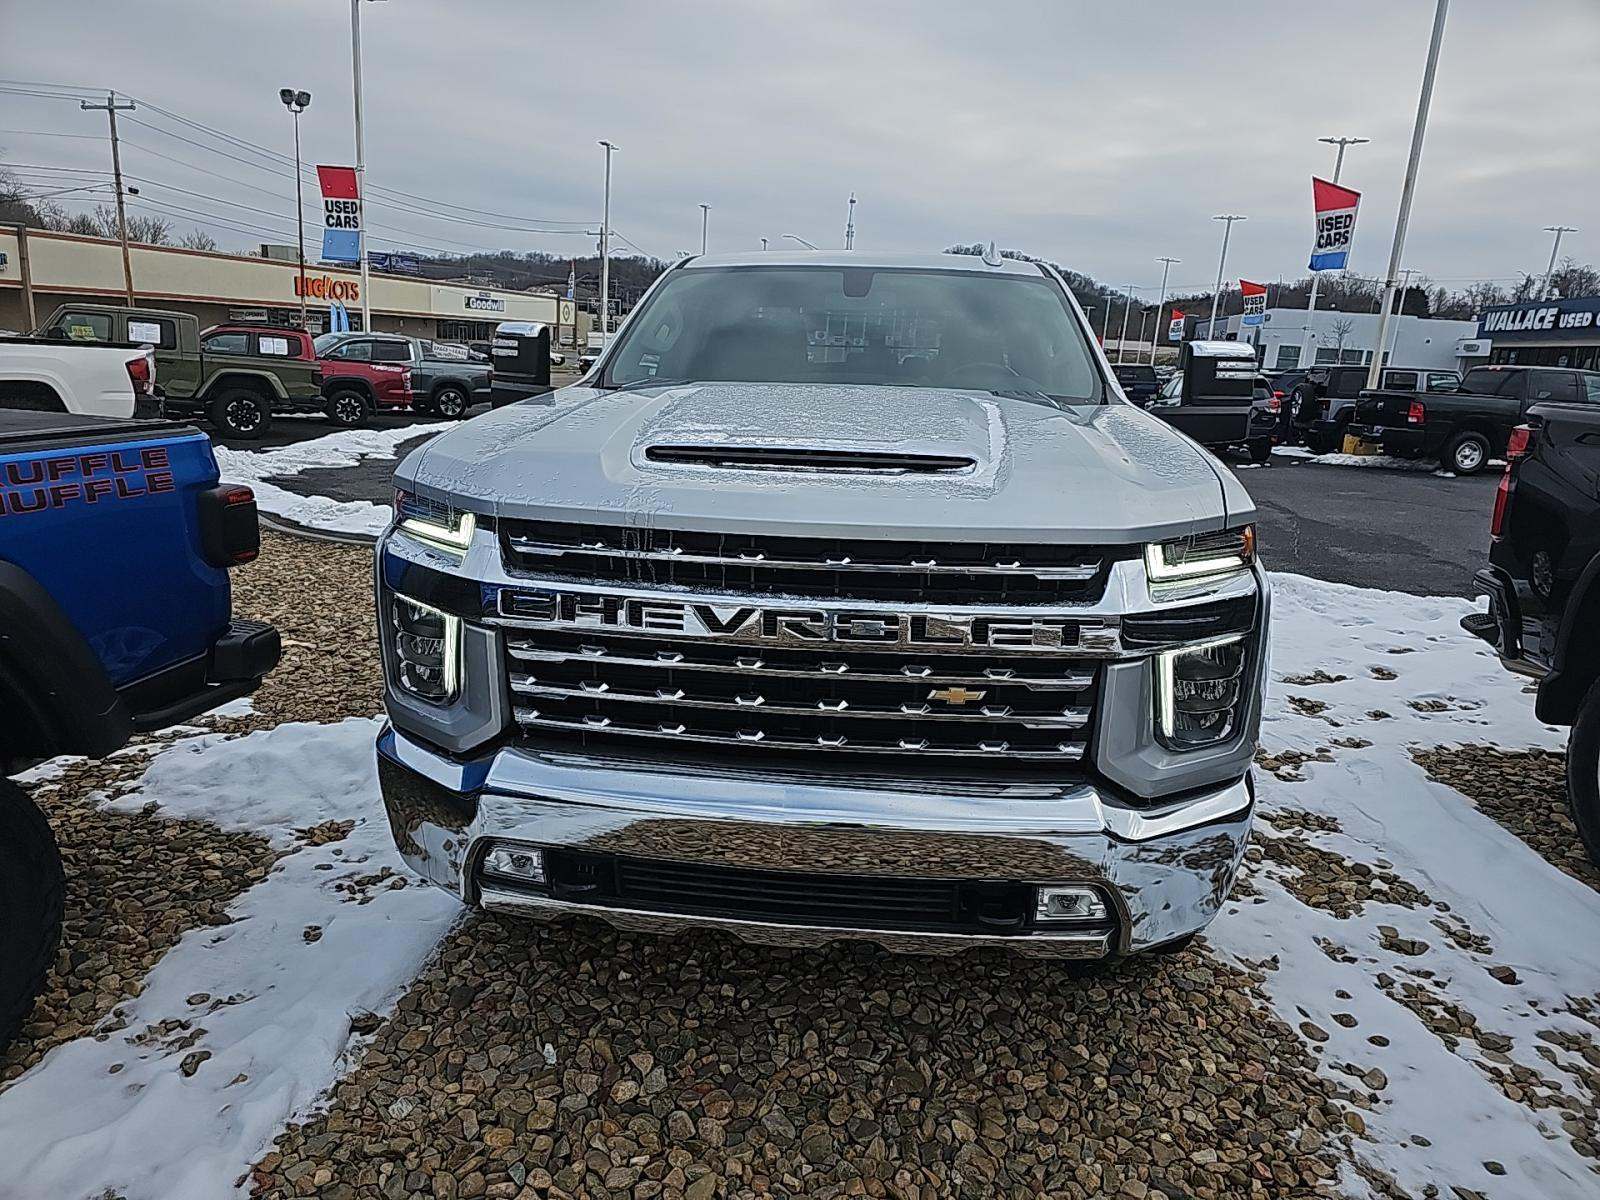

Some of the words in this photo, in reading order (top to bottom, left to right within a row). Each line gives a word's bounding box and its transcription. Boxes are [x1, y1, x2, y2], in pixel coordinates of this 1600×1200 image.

[324, 200, 358, 215] USED
[325, 214, 359, 229] CARS
[1317, 213, 1353, 233] USED
[1317, 230, 1350, 249] CARS
[469, 297, 504, 311] Goodwill
[1244, 295, 1265, 306] USED
[1244, 305, 1264, 316] CARS
[1484, 307, 1559, 332] WALLACE
[1559, 312, 1593, 328] USED
[0, 447, 170, 487] UFFLE
[0, 471, 176, 517] UFFLE
[498, 588, 1105, 648] CHEVROLET
